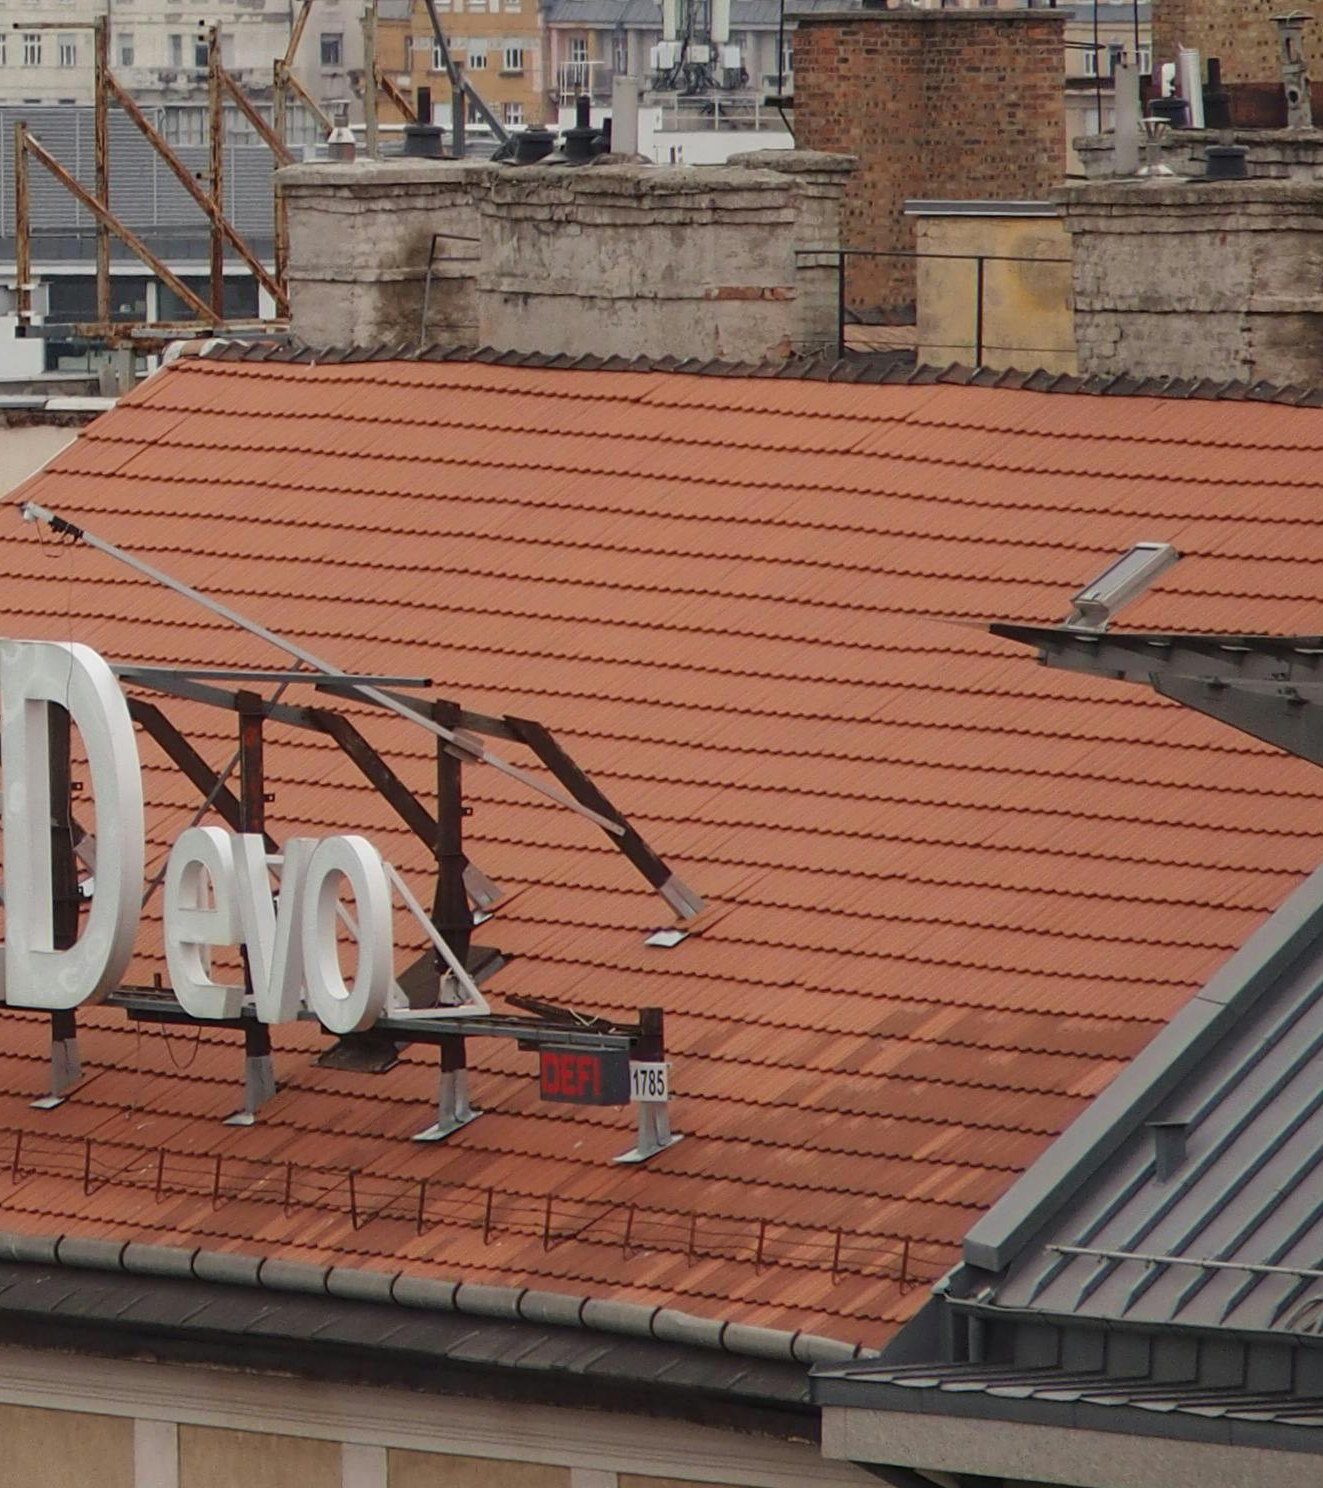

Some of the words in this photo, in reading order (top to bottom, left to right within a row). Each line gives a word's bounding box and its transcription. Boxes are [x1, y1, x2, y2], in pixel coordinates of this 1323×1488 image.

[164, 826, 393, 1034] evo
[540, 1051, 601, 1097] DEFI
[633, 1068, 665, 1096] 1785
